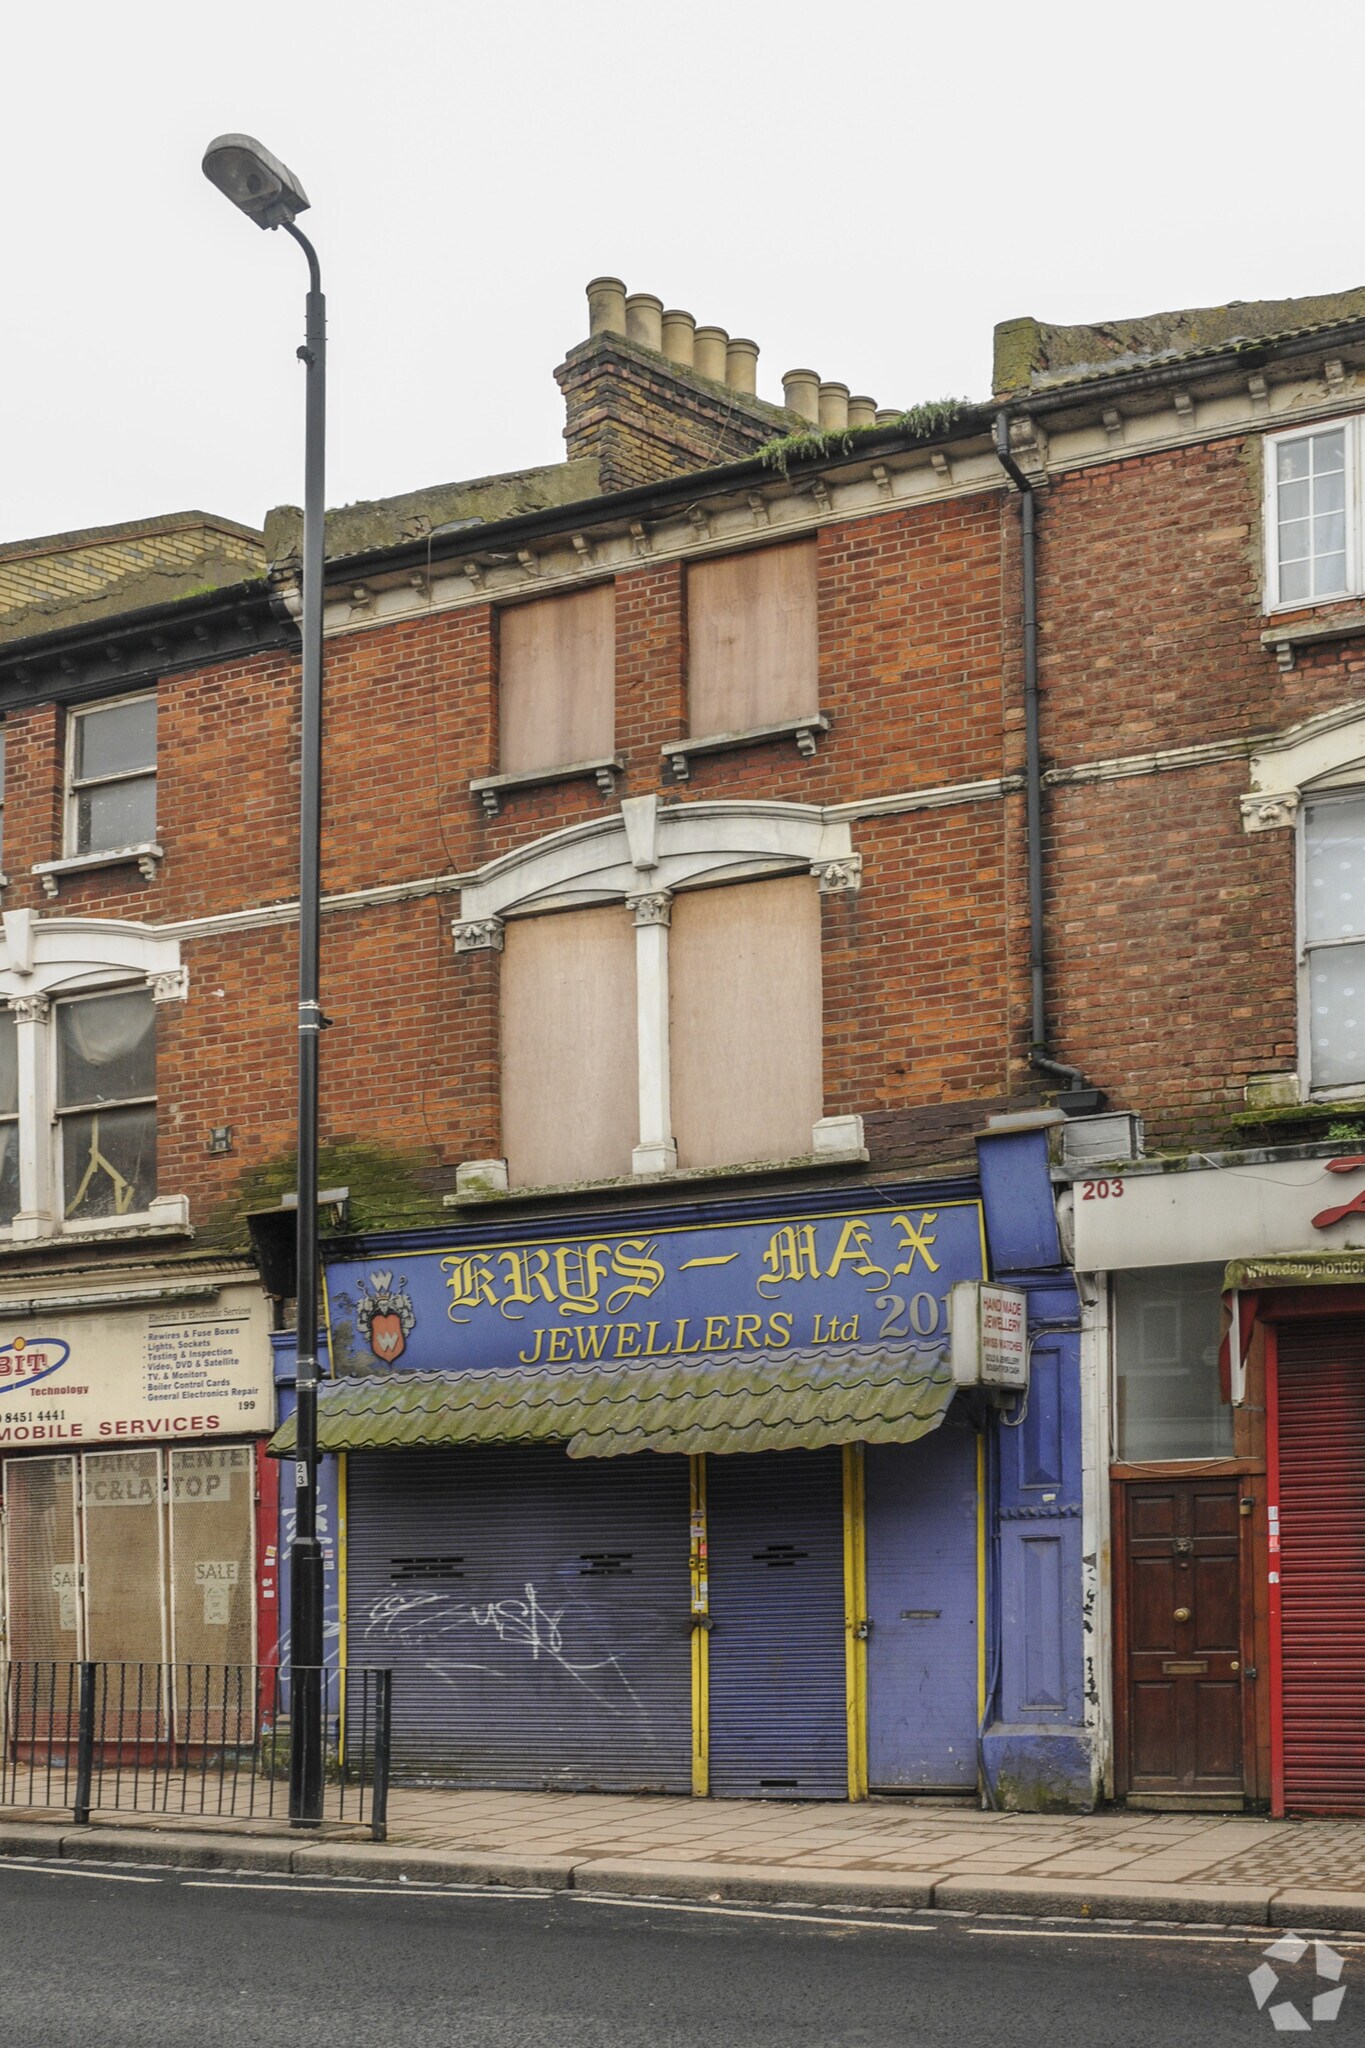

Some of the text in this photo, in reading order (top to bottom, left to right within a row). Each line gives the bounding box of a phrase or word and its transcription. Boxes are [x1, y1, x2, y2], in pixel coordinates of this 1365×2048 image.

[1082, 1178, 1124, 1200] 203
[440, 1239, 665, 1323] KRYS
[756, 1212, 941, 1299] MAX
[223, 1306, 252, 1316] Services
[1002, 1300, 1022, 1316] MADE
[984, 1315, 1021, 1333] JEWELLERY
[148, 1327, 240, 1340] Rewires & Fuse Boxes
[519, 1311, 861, 1363] JEWELLERS Ltd
[148, 1340, 211, 1352] Lights, Sockets
[148, 1348, 233, 1361] Testing & Inspection
[148, 1363, 173, 1371] Video,
[175, 1361, 192, 1369] DVD
[204, 1358, 239, 1366] Satellite
[163, 1372, 169, 1380] &
[172, 1370, 207, 1379] Monitors
[30, 1386, 89, 1396] Technology
[148, 1378, 230, 1391] Boiler Control Cards
[148, 1387, 259, 1401] General Electronics Repair
[239, 1401, 255, 1410] 199
[4, 1412, 33, 1423] 8451
[37, 1410, 65, 1421] 4441
[99, 1415, 220, 1435] SERVICES
[197, 1563, 235, 1580] SALE
